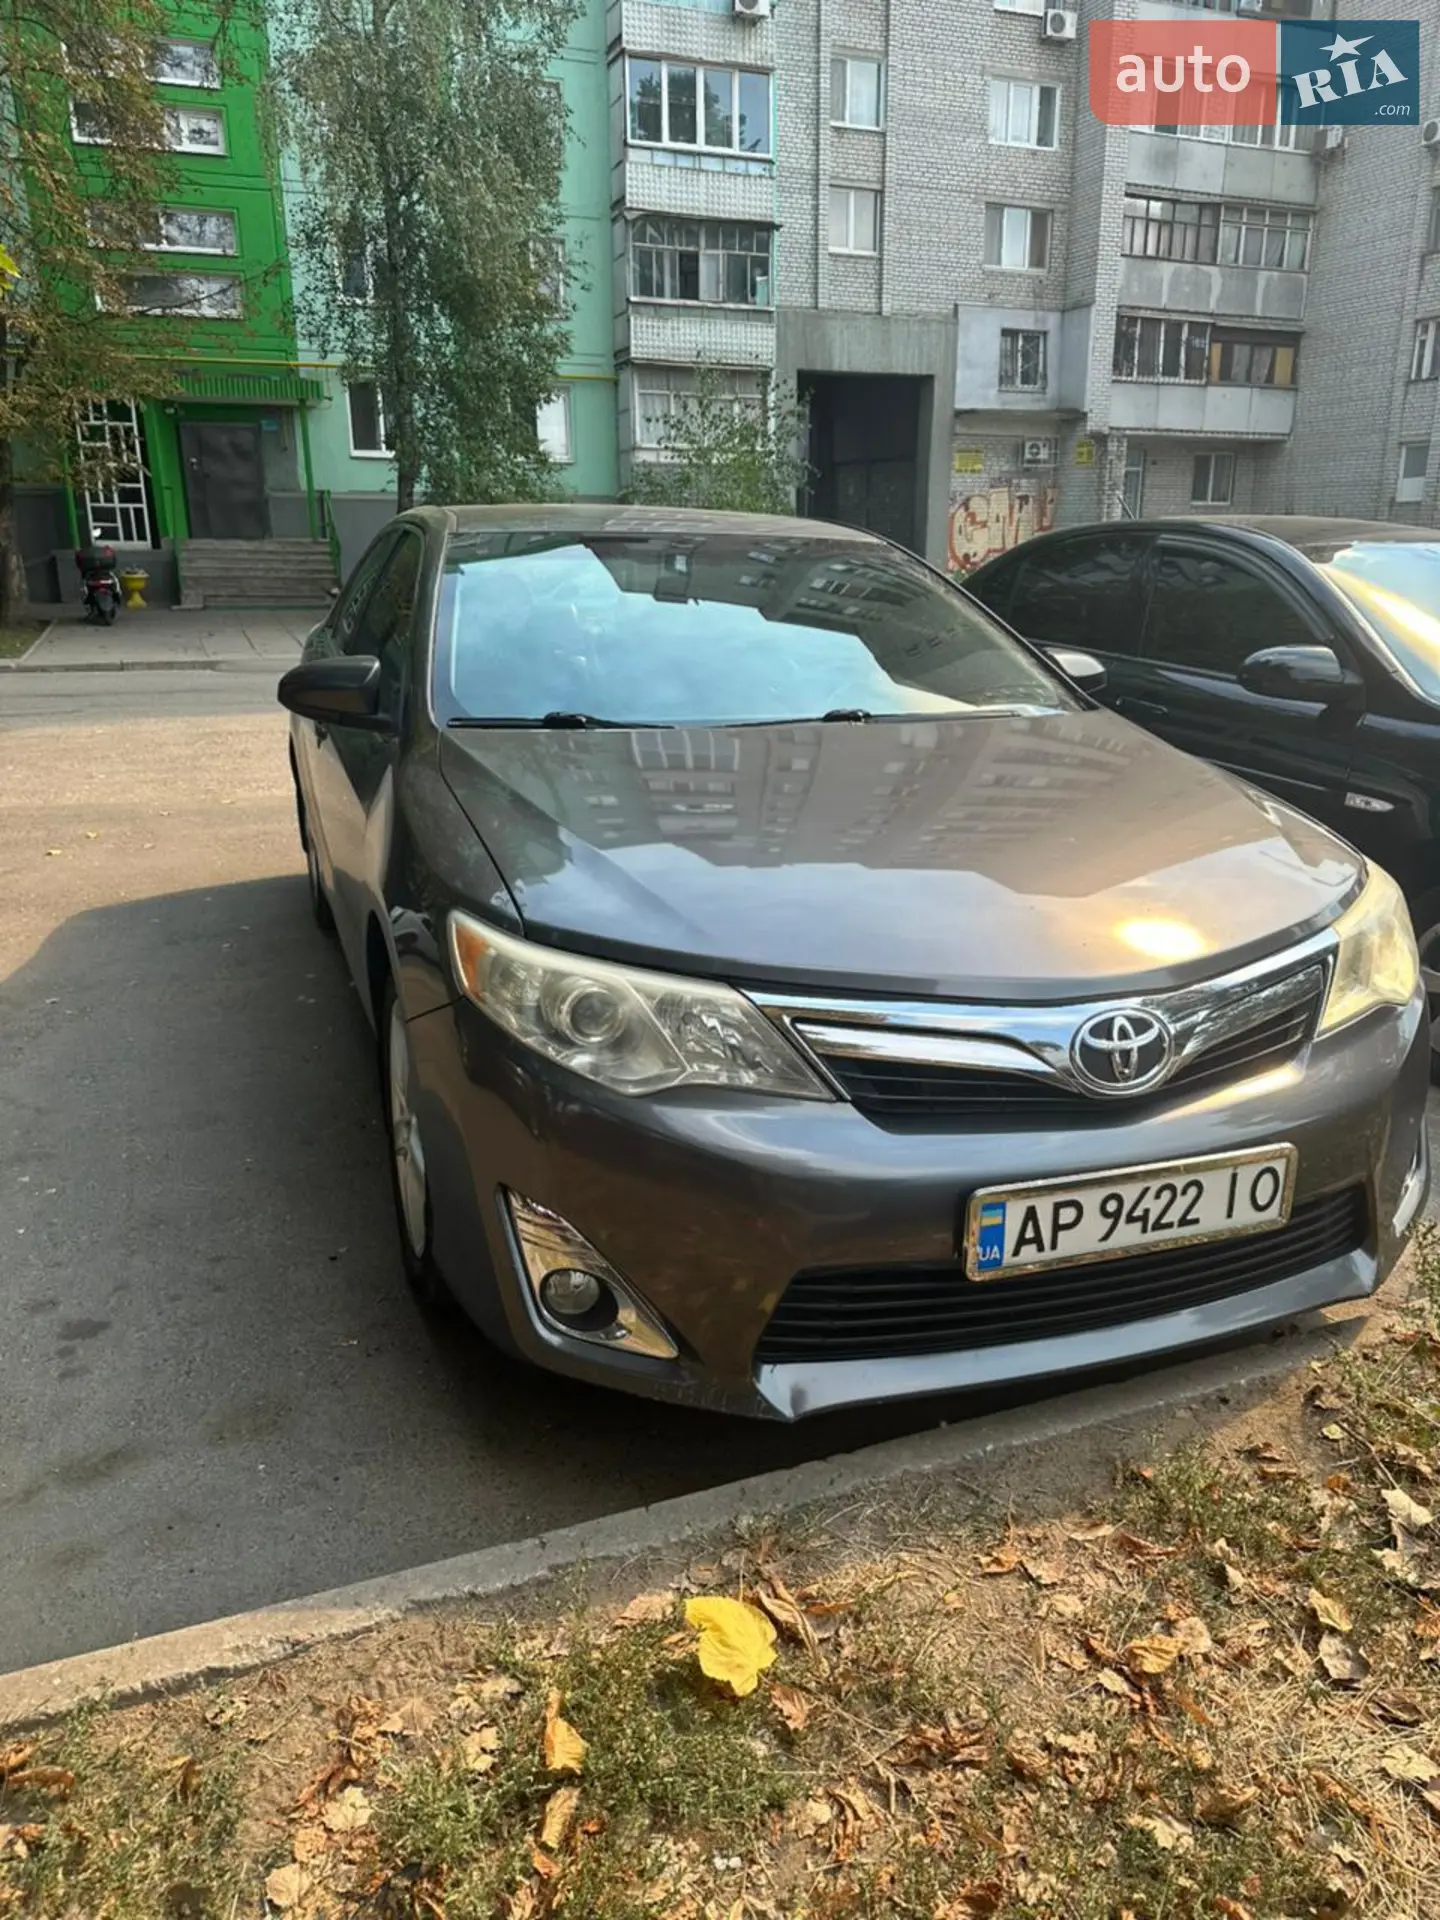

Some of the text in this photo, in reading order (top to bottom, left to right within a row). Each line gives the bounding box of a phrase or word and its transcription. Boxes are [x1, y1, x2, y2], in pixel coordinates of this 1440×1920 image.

[1011, 1199, 1084, 1258] AP
[1097, 1178, 1205, 1243] 9422
[979, 1245, 1001, 1261] UA
